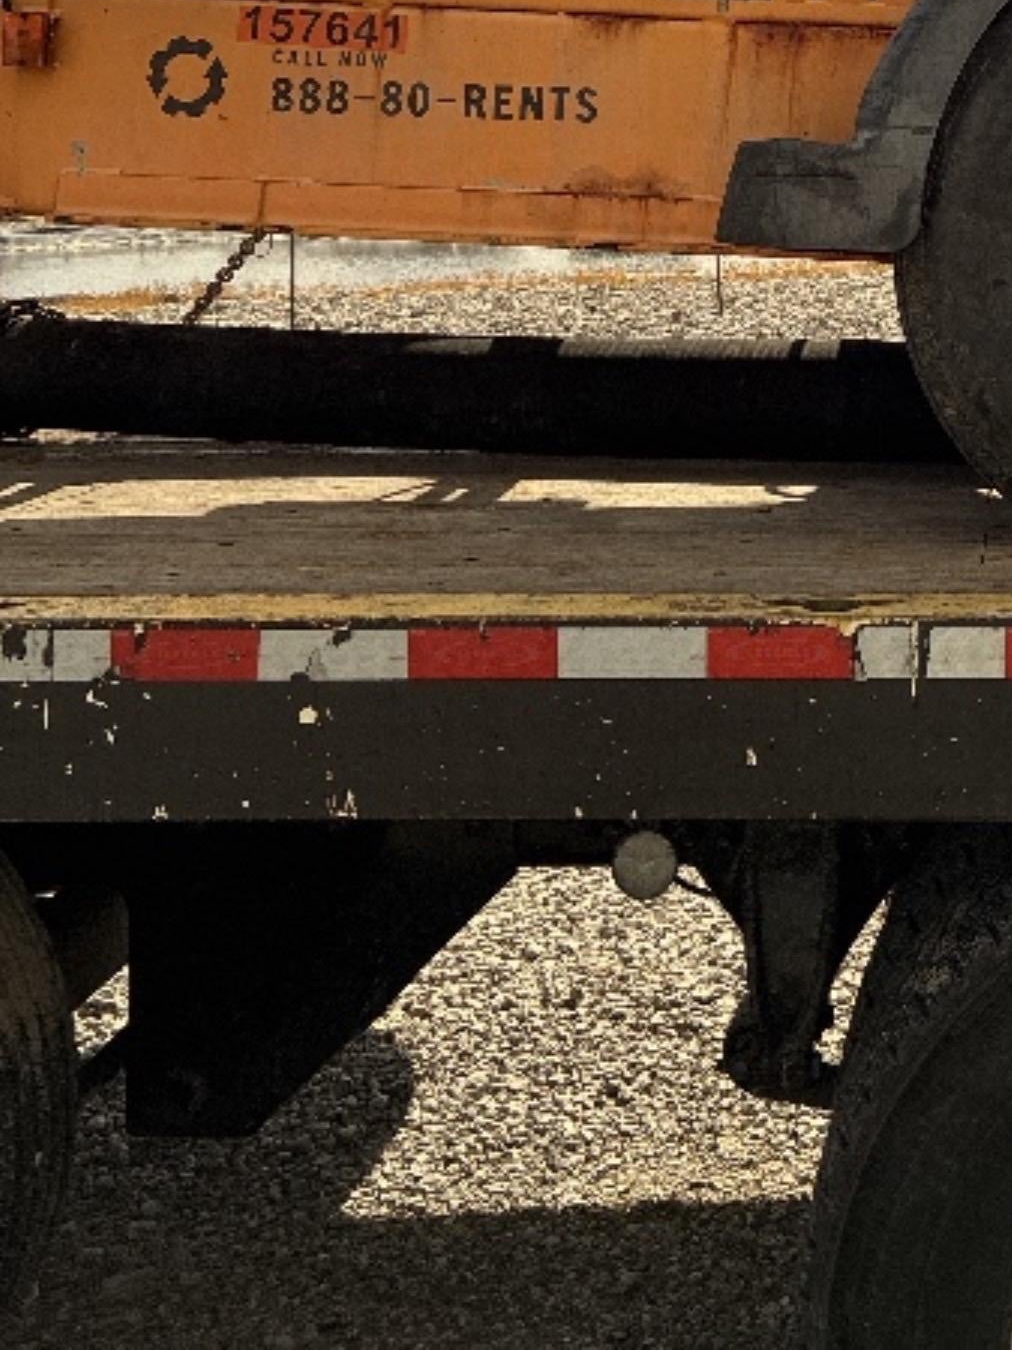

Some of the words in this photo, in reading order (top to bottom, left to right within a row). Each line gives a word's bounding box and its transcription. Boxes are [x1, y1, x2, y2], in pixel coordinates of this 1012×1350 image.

[244, 5, 401, 49] 157641
[272, 48, 327, 67] CALL
[338, 50, 388, 69] NOW
[272, 77, 598, 124] 888-80-RENTS
